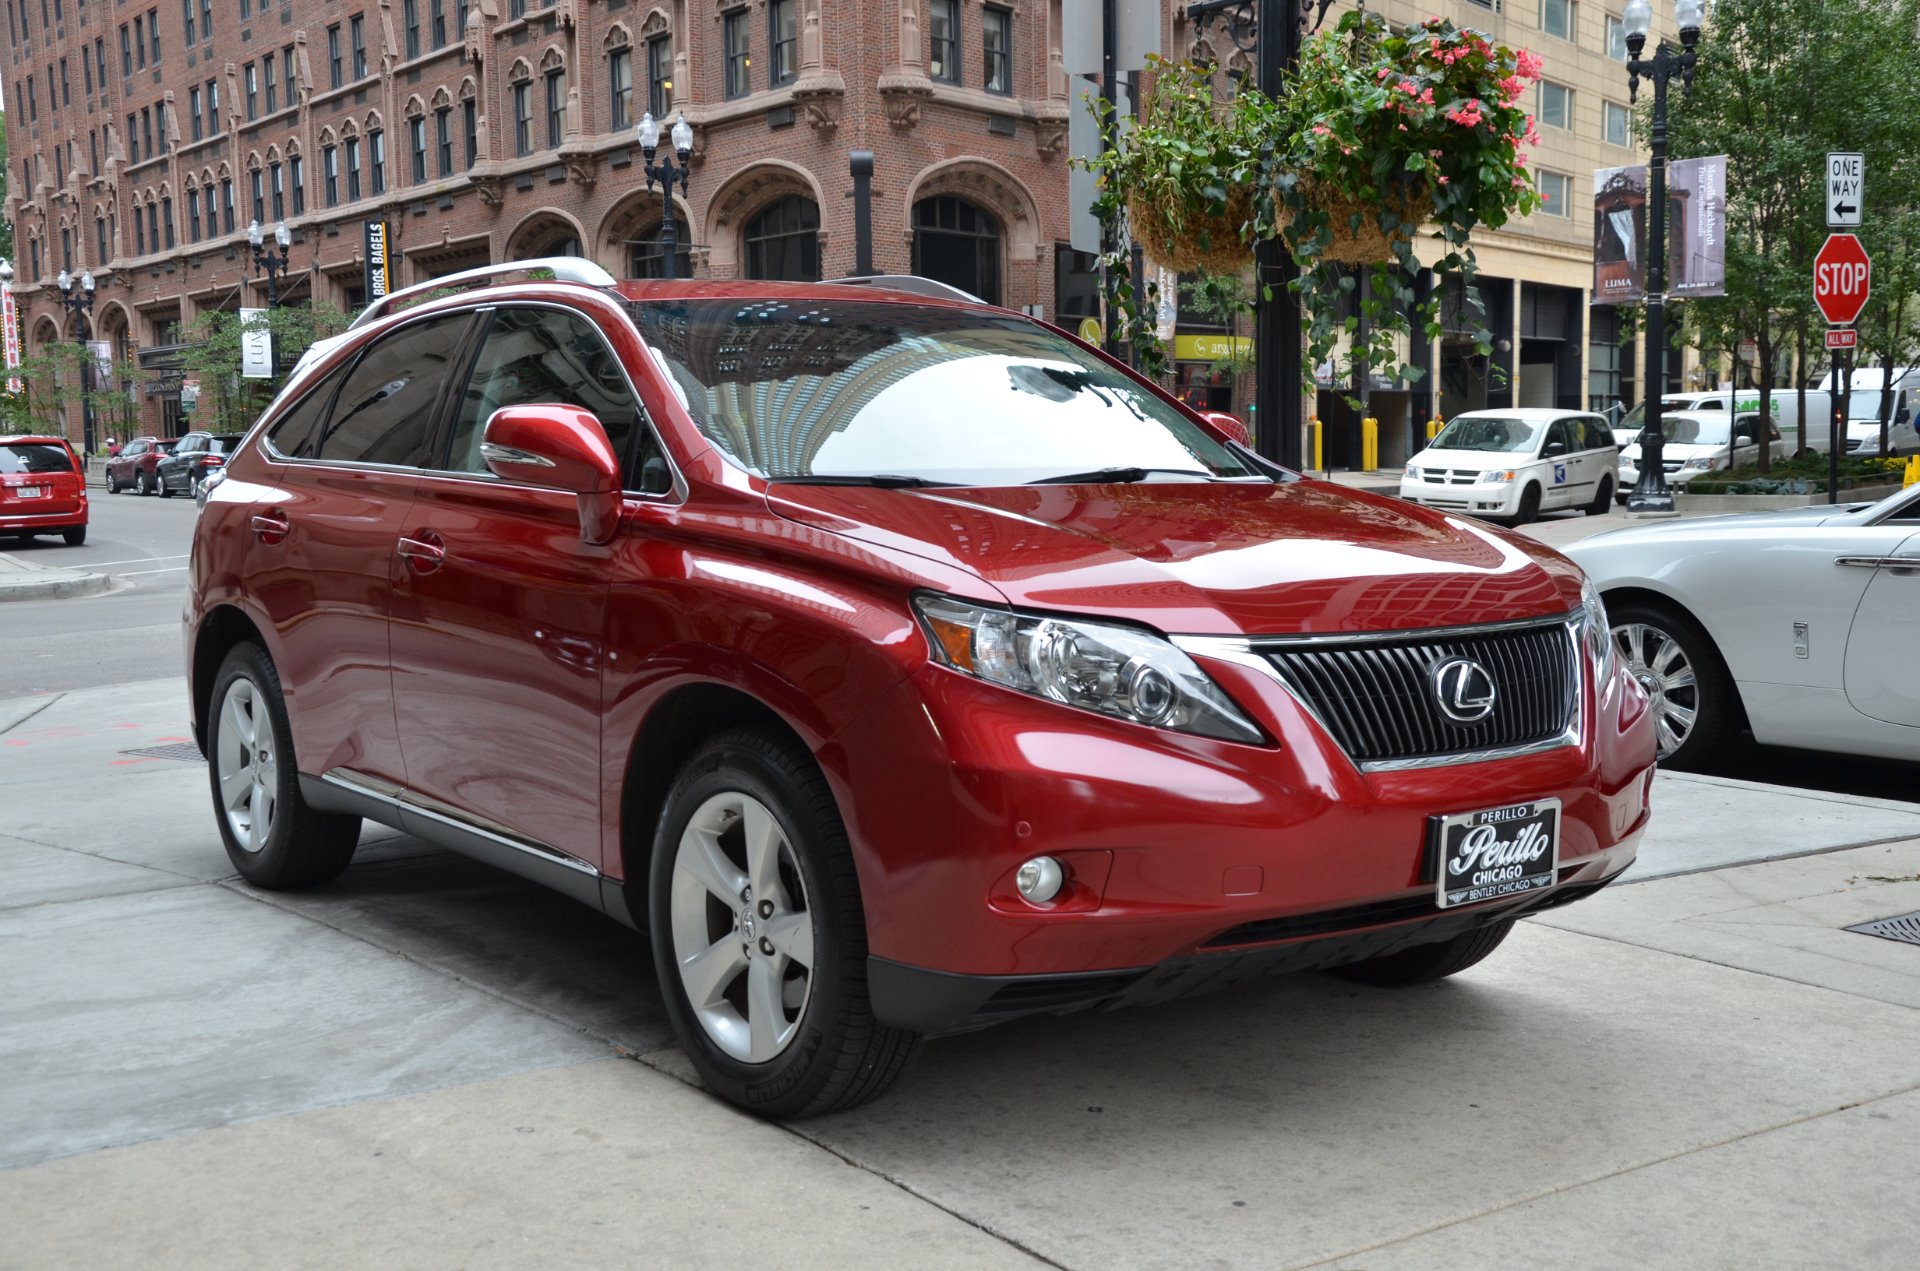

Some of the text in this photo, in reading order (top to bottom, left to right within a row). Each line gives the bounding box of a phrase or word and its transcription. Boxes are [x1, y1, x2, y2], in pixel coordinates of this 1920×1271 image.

[1832, 160, 1859, 177] ONE
[1707, 164, 1716, 200] Marcella
[1832, 180, 1859, 197] WAY
[370, 223, 386, 296] BROS. BAGELS
[1605, 278, 1632, 288] LUMA
[1818, 262, 1867, 296] STOP
[4, 289, 19, 390] HERSHES
[250, 328, 265, 366] LUM
[1828, 333, 1854, 345] ALL WAY
[1480, 806, 1527, 824] PERILLO
[1449, 822, 1549, 876] Perillo
[1472, 865, 1523, 886] CHICAGO
[1469, 879, 1530, 900] BENTLEY CHICAGO
